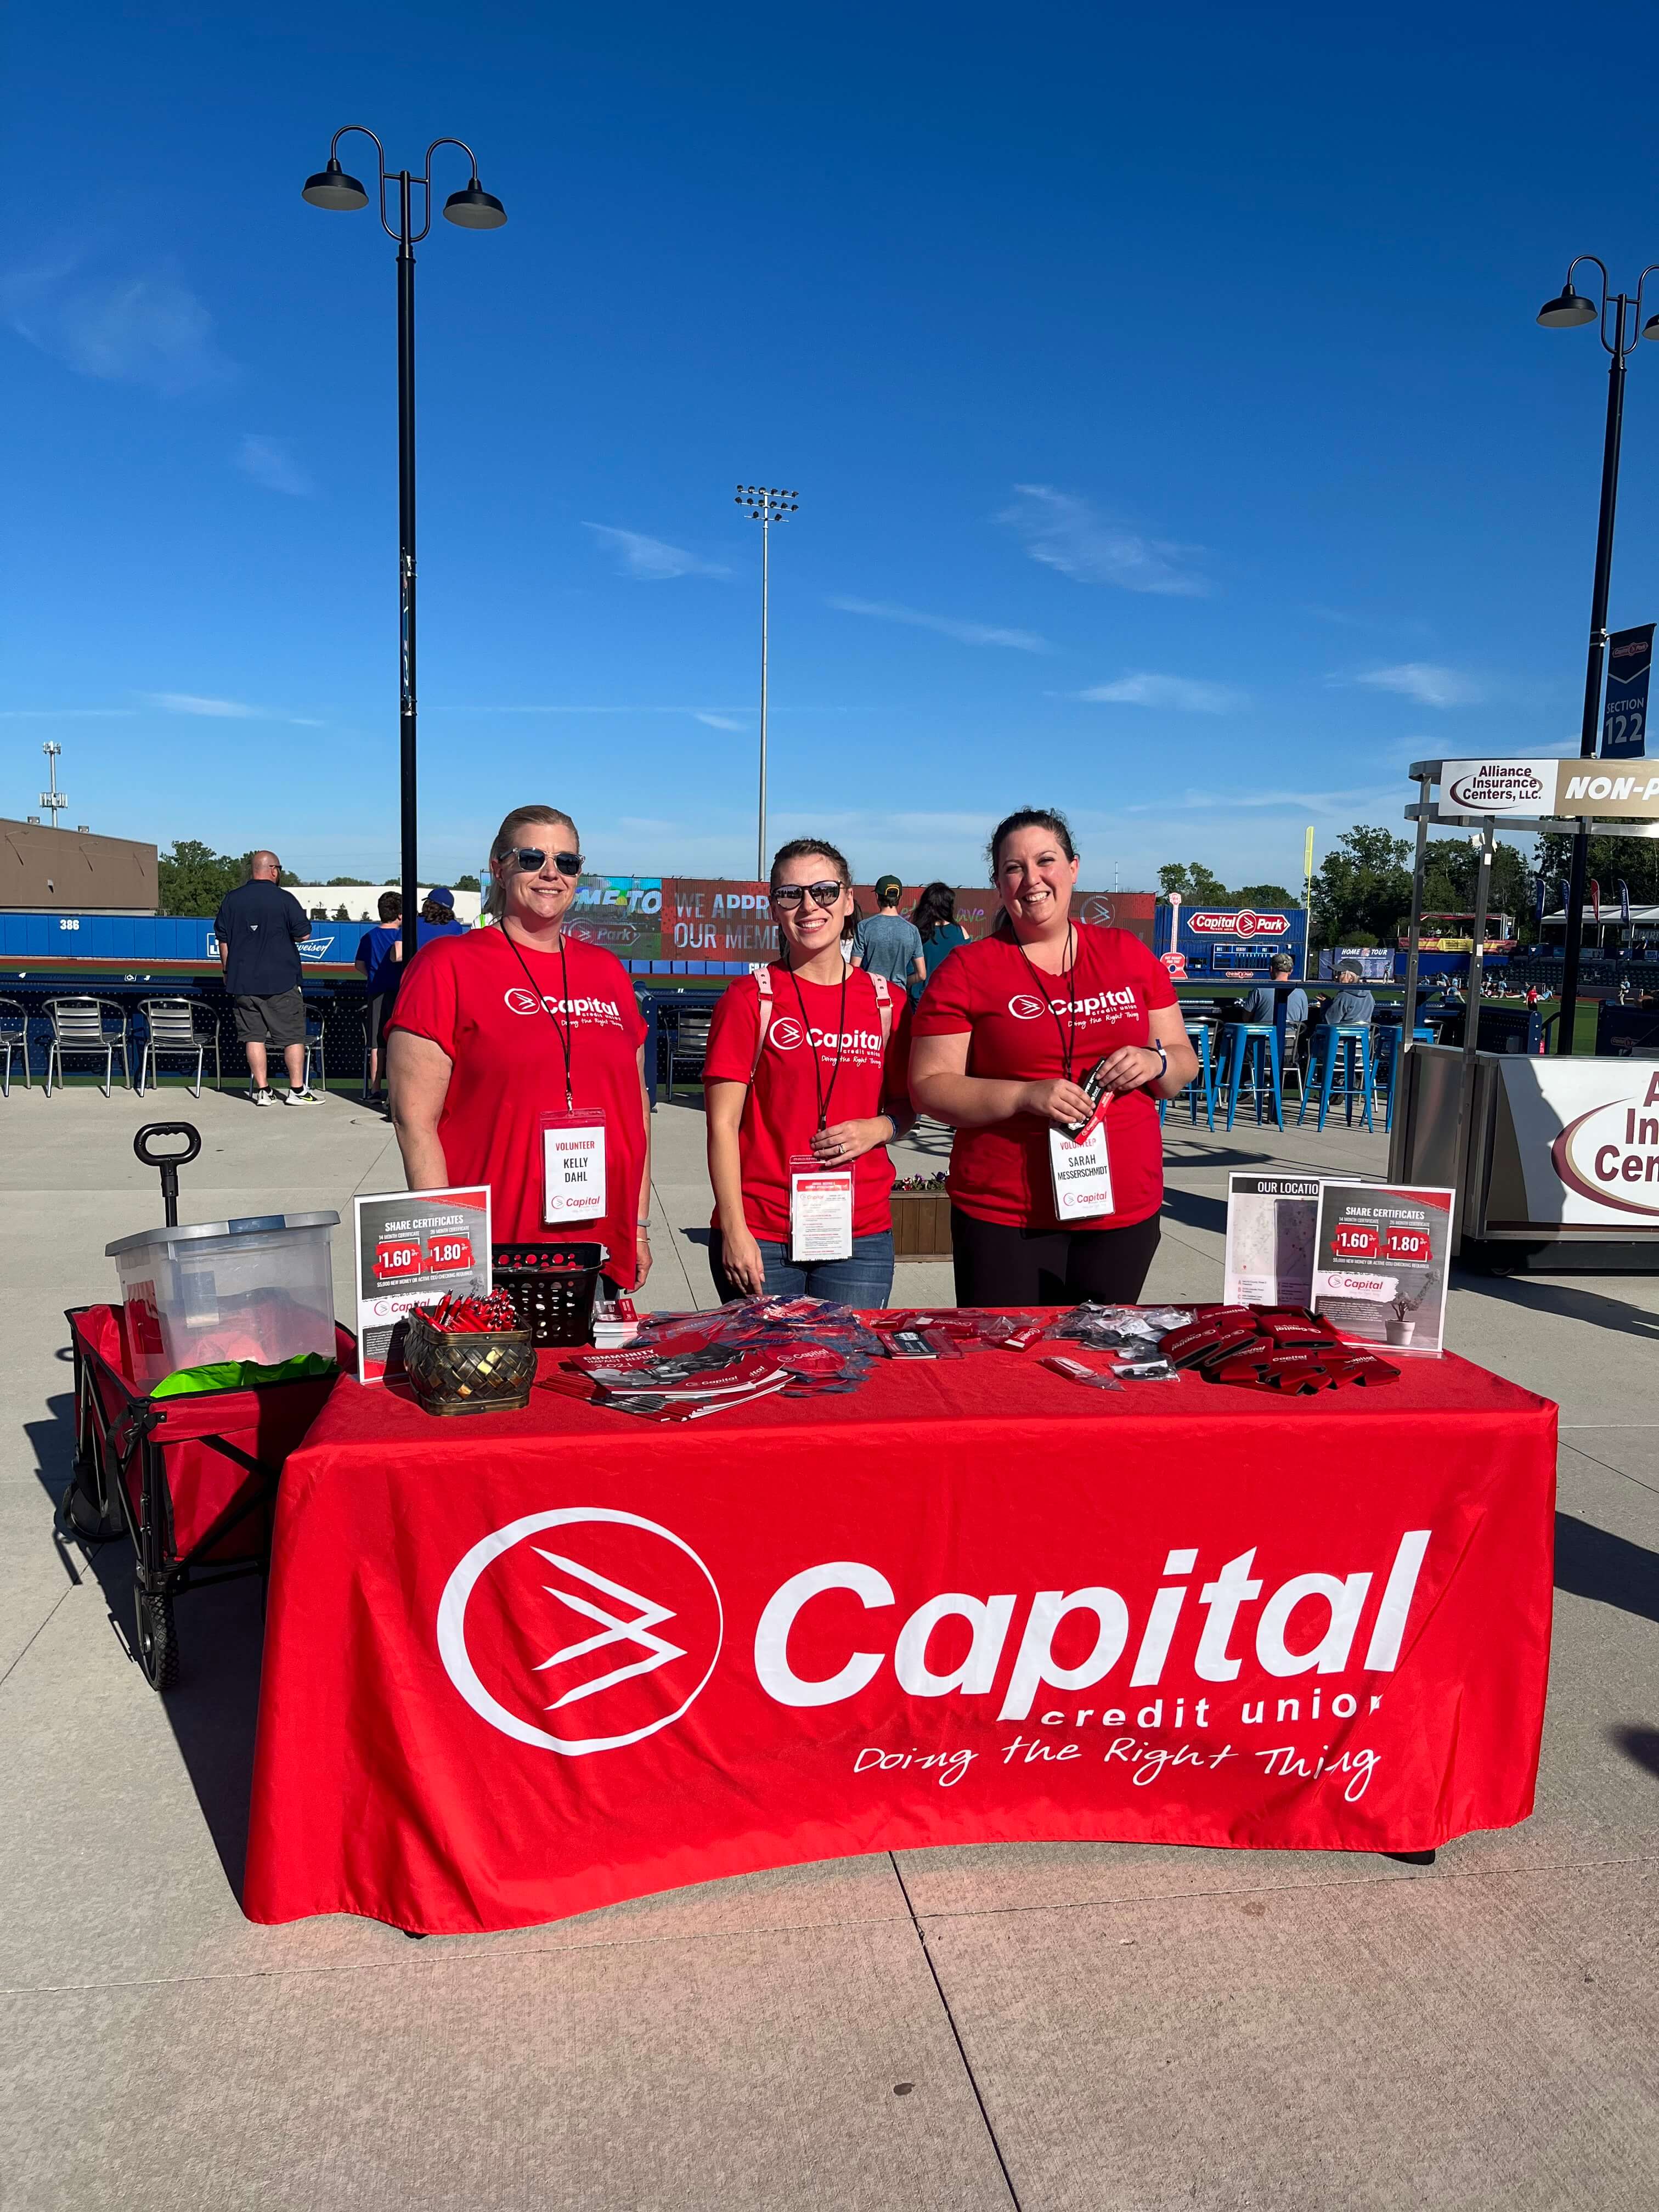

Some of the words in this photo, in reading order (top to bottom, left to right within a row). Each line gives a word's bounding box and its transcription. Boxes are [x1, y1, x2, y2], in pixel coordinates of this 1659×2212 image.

[1606, 697, 1644, 714] SECTION
[1606, 713, 1643, 745] 122
[1479, 765, 1532, 777] Alliance
[1472, 777, 1537, 788] Insurance
[1463, 788, 1516, 801] Centers,
[1519, 791, 1541, 800] LLC.
[627, 890, 662, 915] TO
[674, 892, 706, 918] WE
[711, 894, 773, 920] APPR
[60, 919, 80, 930] 386
[1196, 915, 1236, 929] Capital
[1257, 918, 1283, 930] Park
[674, 922, 717, 949] OUR
[298, 942, 329, 952] weiser
[540, 996, 619, 1016] Capital
[1048, 986, 1135, 1016] Capital
[1092, 1007, 1117, 1016] credit
[1068, 1020, 1087, 1030] Ding
[1105, 1013, 1122, 1024] Right
[805, 1028, 882, 1053] Capital
[821, 1055, 838, 1066] Doing
[853, 1056, 867, 1067] Right
[1624, 1108, 1659, 1146] In
[555, 1141, 595, 1151] VOLUNTEER
[563, 1157, 588, 1169] KELLY
[1068, 1154, 1096, 1167] SARAH
[565, 1171, 588, 1183] DAHL
[1057, 1165, 1108, 1181] MESSERSCHMIDT
[1257, 1181, 1278, 1193] OUR
[1280, 1182, 1318, 1195] LOCATIO
[566, 1195, 600, 1207] Capital
[1076, 1191, 1107, 1204] Capital
[1345, 1206, 1372, 1217] SHARE
[1373, 1208, 1425, 1220] CERTIFICATES
[385, 1220, 411, 1232] SHARE
[413, 1215, 464, 1229] CERTIFICATES
[398, 1231, 420, 1239] CERTIFICATE
[1340, 1232, 1368, 1249] 1.60
[1391, 1235, 1419, 1252] 1.80
[382, 1249, 411, 1268] 1.60
[433, 1243, 461, 1262] 1.80
[1344, 1278, 1384, 1290] Capital
[583, 1349, 654, 1361] COMMUNITY
[625, 1353, 659, 1362] REPORT
[793, 1348, 830, 1359] Capital
[749, 1365, 765, 1377] ital
[701, 1375, 738, 1385] Capital
[753, 1529, 1432, 1722] Capital
[1040, 1697, 1210, 1729] credit
[854, 1746, 979, 1787] Doing
[1001, 1735, 1083, 1763] the
[1103, 1736, 1239, 1786] Right
